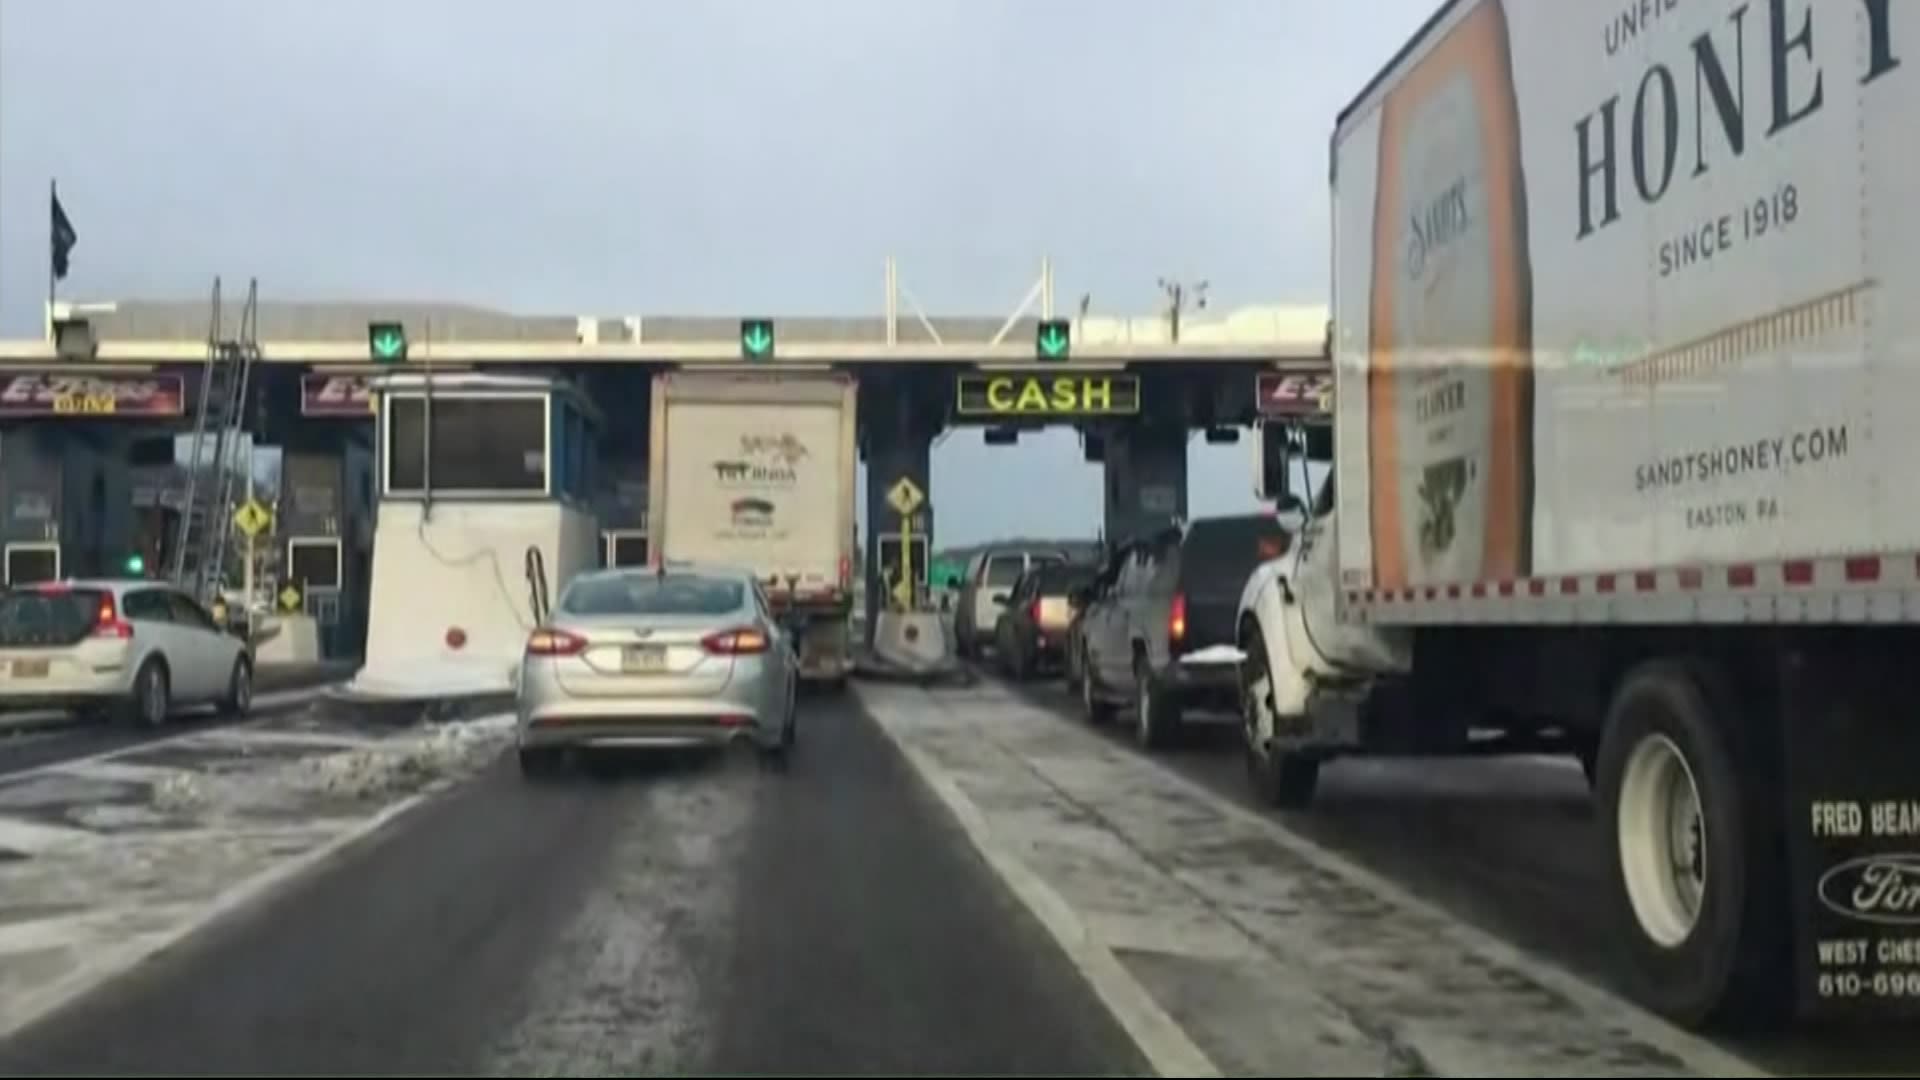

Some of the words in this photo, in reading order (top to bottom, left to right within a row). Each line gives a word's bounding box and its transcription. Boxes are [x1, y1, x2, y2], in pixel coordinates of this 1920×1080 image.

[1659, 214, 1732, 277] SINCE
[1744, 183, 1798, 241] 1918
[987, 377, 1111, 411] CASH
[1635, 424, 1848, 491] SANDTSHONEY.COM
[1685, 503, 1746, 529] EASTON
[1811, 800, 1862, 837] FRED
[1817, 938, 1868, 965] WEST
